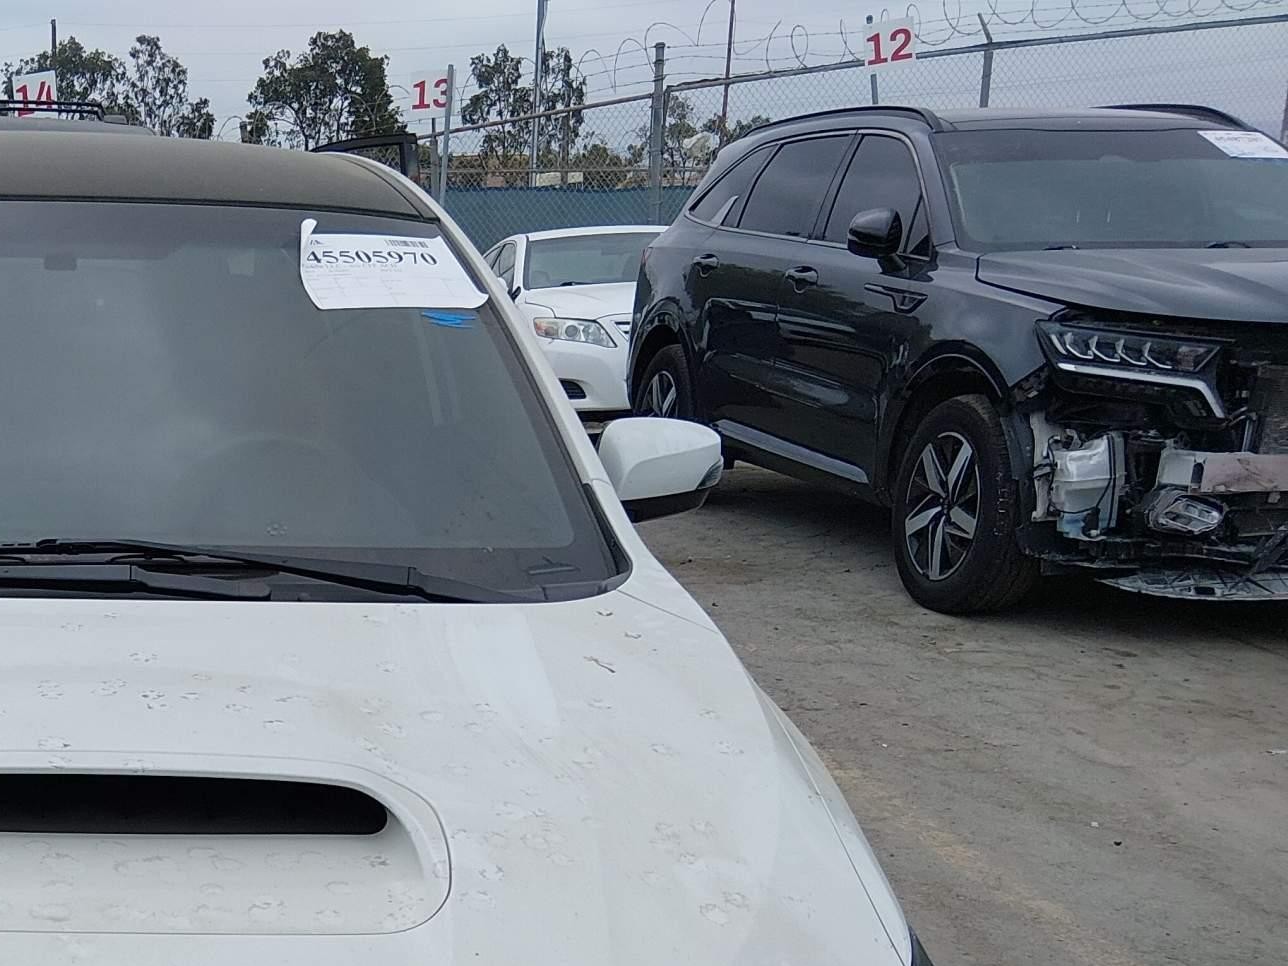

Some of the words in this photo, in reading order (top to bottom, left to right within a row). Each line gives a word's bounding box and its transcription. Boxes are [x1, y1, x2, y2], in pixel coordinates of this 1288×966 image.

[866, 28, 913, 66] 12
[15, 81, 55, 118] 14
[412, 78, 448, 110] 13
[306, 250, 438, 266] 45505970
